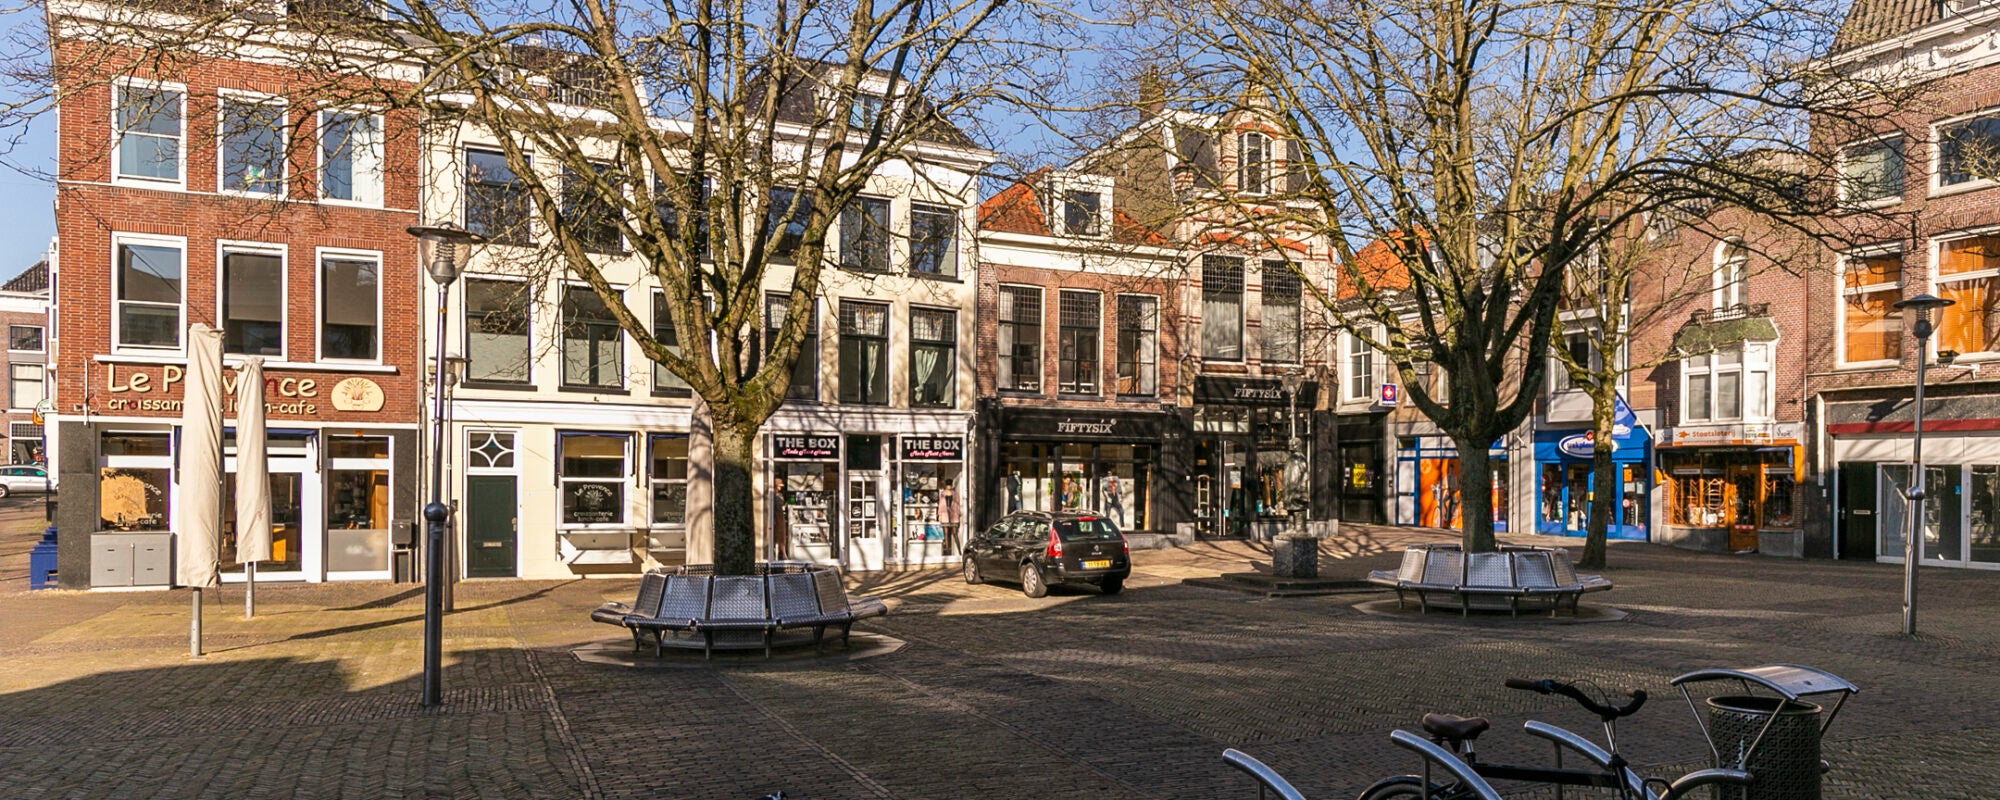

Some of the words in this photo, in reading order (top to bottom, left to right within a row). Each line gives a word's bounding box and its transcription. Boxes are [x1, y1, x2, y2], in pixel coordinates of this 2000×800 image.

[107, 363, 151, 393] Le
[163, 365, 318, 397] Pvnce
[108, 398, 184, 411] croissan
[776, 437, 805, 448] THE
[808, 438, 836, 448] BOX
[904, 439, 931, 449] THE
[933, 440, 960, 450] BOX
